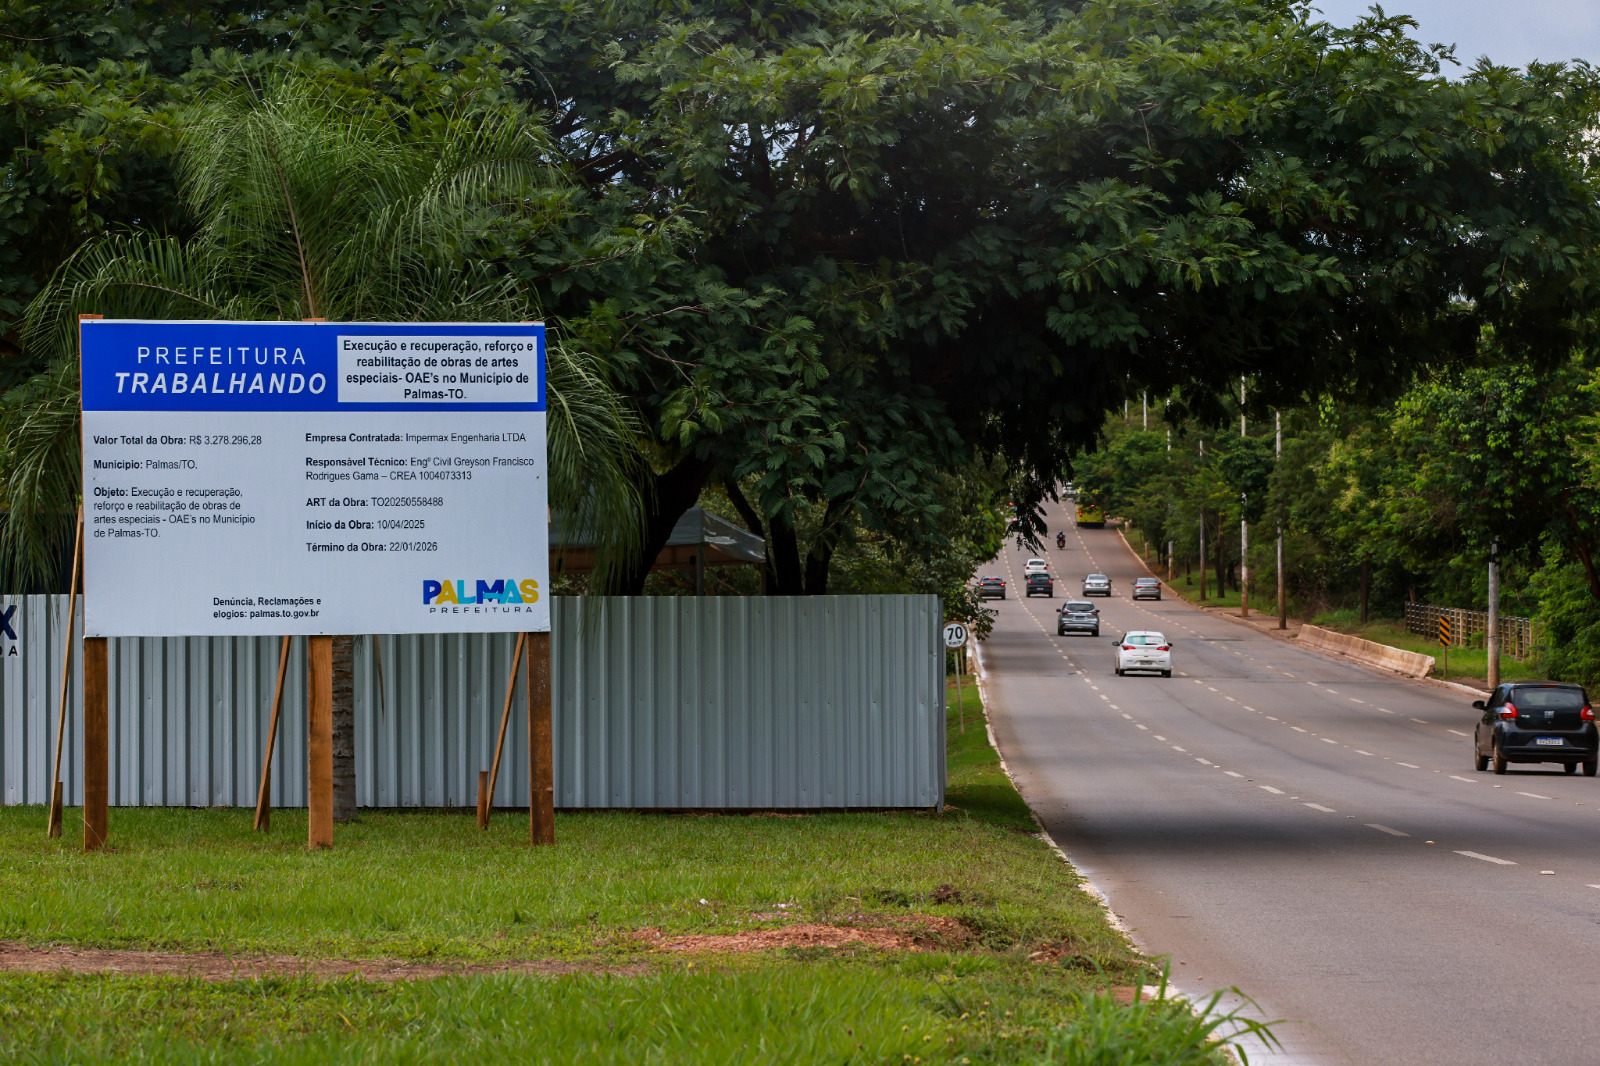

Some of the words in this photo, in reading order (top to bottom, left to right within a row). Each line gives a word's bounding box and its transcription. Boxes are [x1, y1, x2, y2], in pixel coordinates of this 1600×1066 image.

[343, 339, 398, 354] Execução
[400, 342, 408, 352] e
[409, 340, 482, 354] recuperação,
[484, 339, 525, 354] reforço
[526, 342, 534, 352] e
[137, 346, 306, 365] PREFEITURA
[356, 355, 422, 370] reabilitação
[423, 356, 438, 368] de
[440, 356, 472, 368] obras
[474, 356, 489, 368] de
[490, 356, 519, 368] artes
[115, 372, 327, 395] TRABALHANDO
[345, 371, 403, 386] especiais-
[442, 374, 458, 384] no
[459, 371, 514, 386] Município
[514, 371, 530, 384] de
[403, 388, 468, 400] Palmas-TO.
[92, 434, 119, 446] Valor
[119, 435, 144, 446] Total
[145, 435, 158, 446] da
[159, 435, 187, 446] Obra:
[189, 434, 203, 446] R$
[203, 435, 263, 446] 3.278.296,28
[305, 432, 347, 445] Empresa
[348, 432, 404, 443] Contratada:
[405, 432, 449, 445] Impermax
[450, 432, 500, 445] Engenharia
[501, 432, 527, 442] LTDA
[145, 459, 198, 470] Palmas/TO.
[305, 456, 366, 469] Responsável
[367, 456, 408, 467] Técnico:
[432, 456, 452, 467] Civil
[453, 456, 491, 469] Greyson
[492, 456, 535, 467] Francisco
[305, 470, 351, 483] Rodrigues
[352, 470, 379, 481] Gama
[389, 470, 418, 481] CREA
[418, 470, 473, 481] 1004073313
[93, 486, 129, 500] Objeto:
[131, 486, 176, 499] Execução
[176, 489, 183, 497] e
[185, 487, 243, 499] recuperação,
[93, 500, 126, 513] reforço
[126, 502, 134, 511] e
[135, 500, 187, 513] reabilitação
[188, 500, 201, 511] de
[202, 500, 228, 511] obras
[228, 500, 241, 511] de
[305, 497, 327, 507] ART
[328, 497, 341, 507] da
[342, 496, 369, 507] Obra:
[93, 514, 117, 525] artes
[118, 514, 161, 526] especiais
[199, 516, 211, 524] no
[306, 519, 333, 530] Início
[333, 519, 347, 530] da
[347, 519, 375, 530] Obra:
[376, 519, 426, 530] 10/04/2025
[93, 528, 106, 538] de
[107, 527, 161, 538] Palmas-TO.
[305, 542, 345, 553] Término
[346, 542, 359, 553] da
[360, 541, 387, 552] Obra:
[389, 541, 439, 552] 22/01/2026
[423, 578, 539, 605] PALMAS
[212, 596, 256, 607] Denúncia,
[257, 596, 315, 608] Reclamações
[315, 598, 322, 606] e
[212, 609, 248, 621] elogios:
[249, 608, 320, 620] palmas.to.gov.br
[429, 606, 533, 614] PREFEITURA
[947, 626, 963, 640] 70
